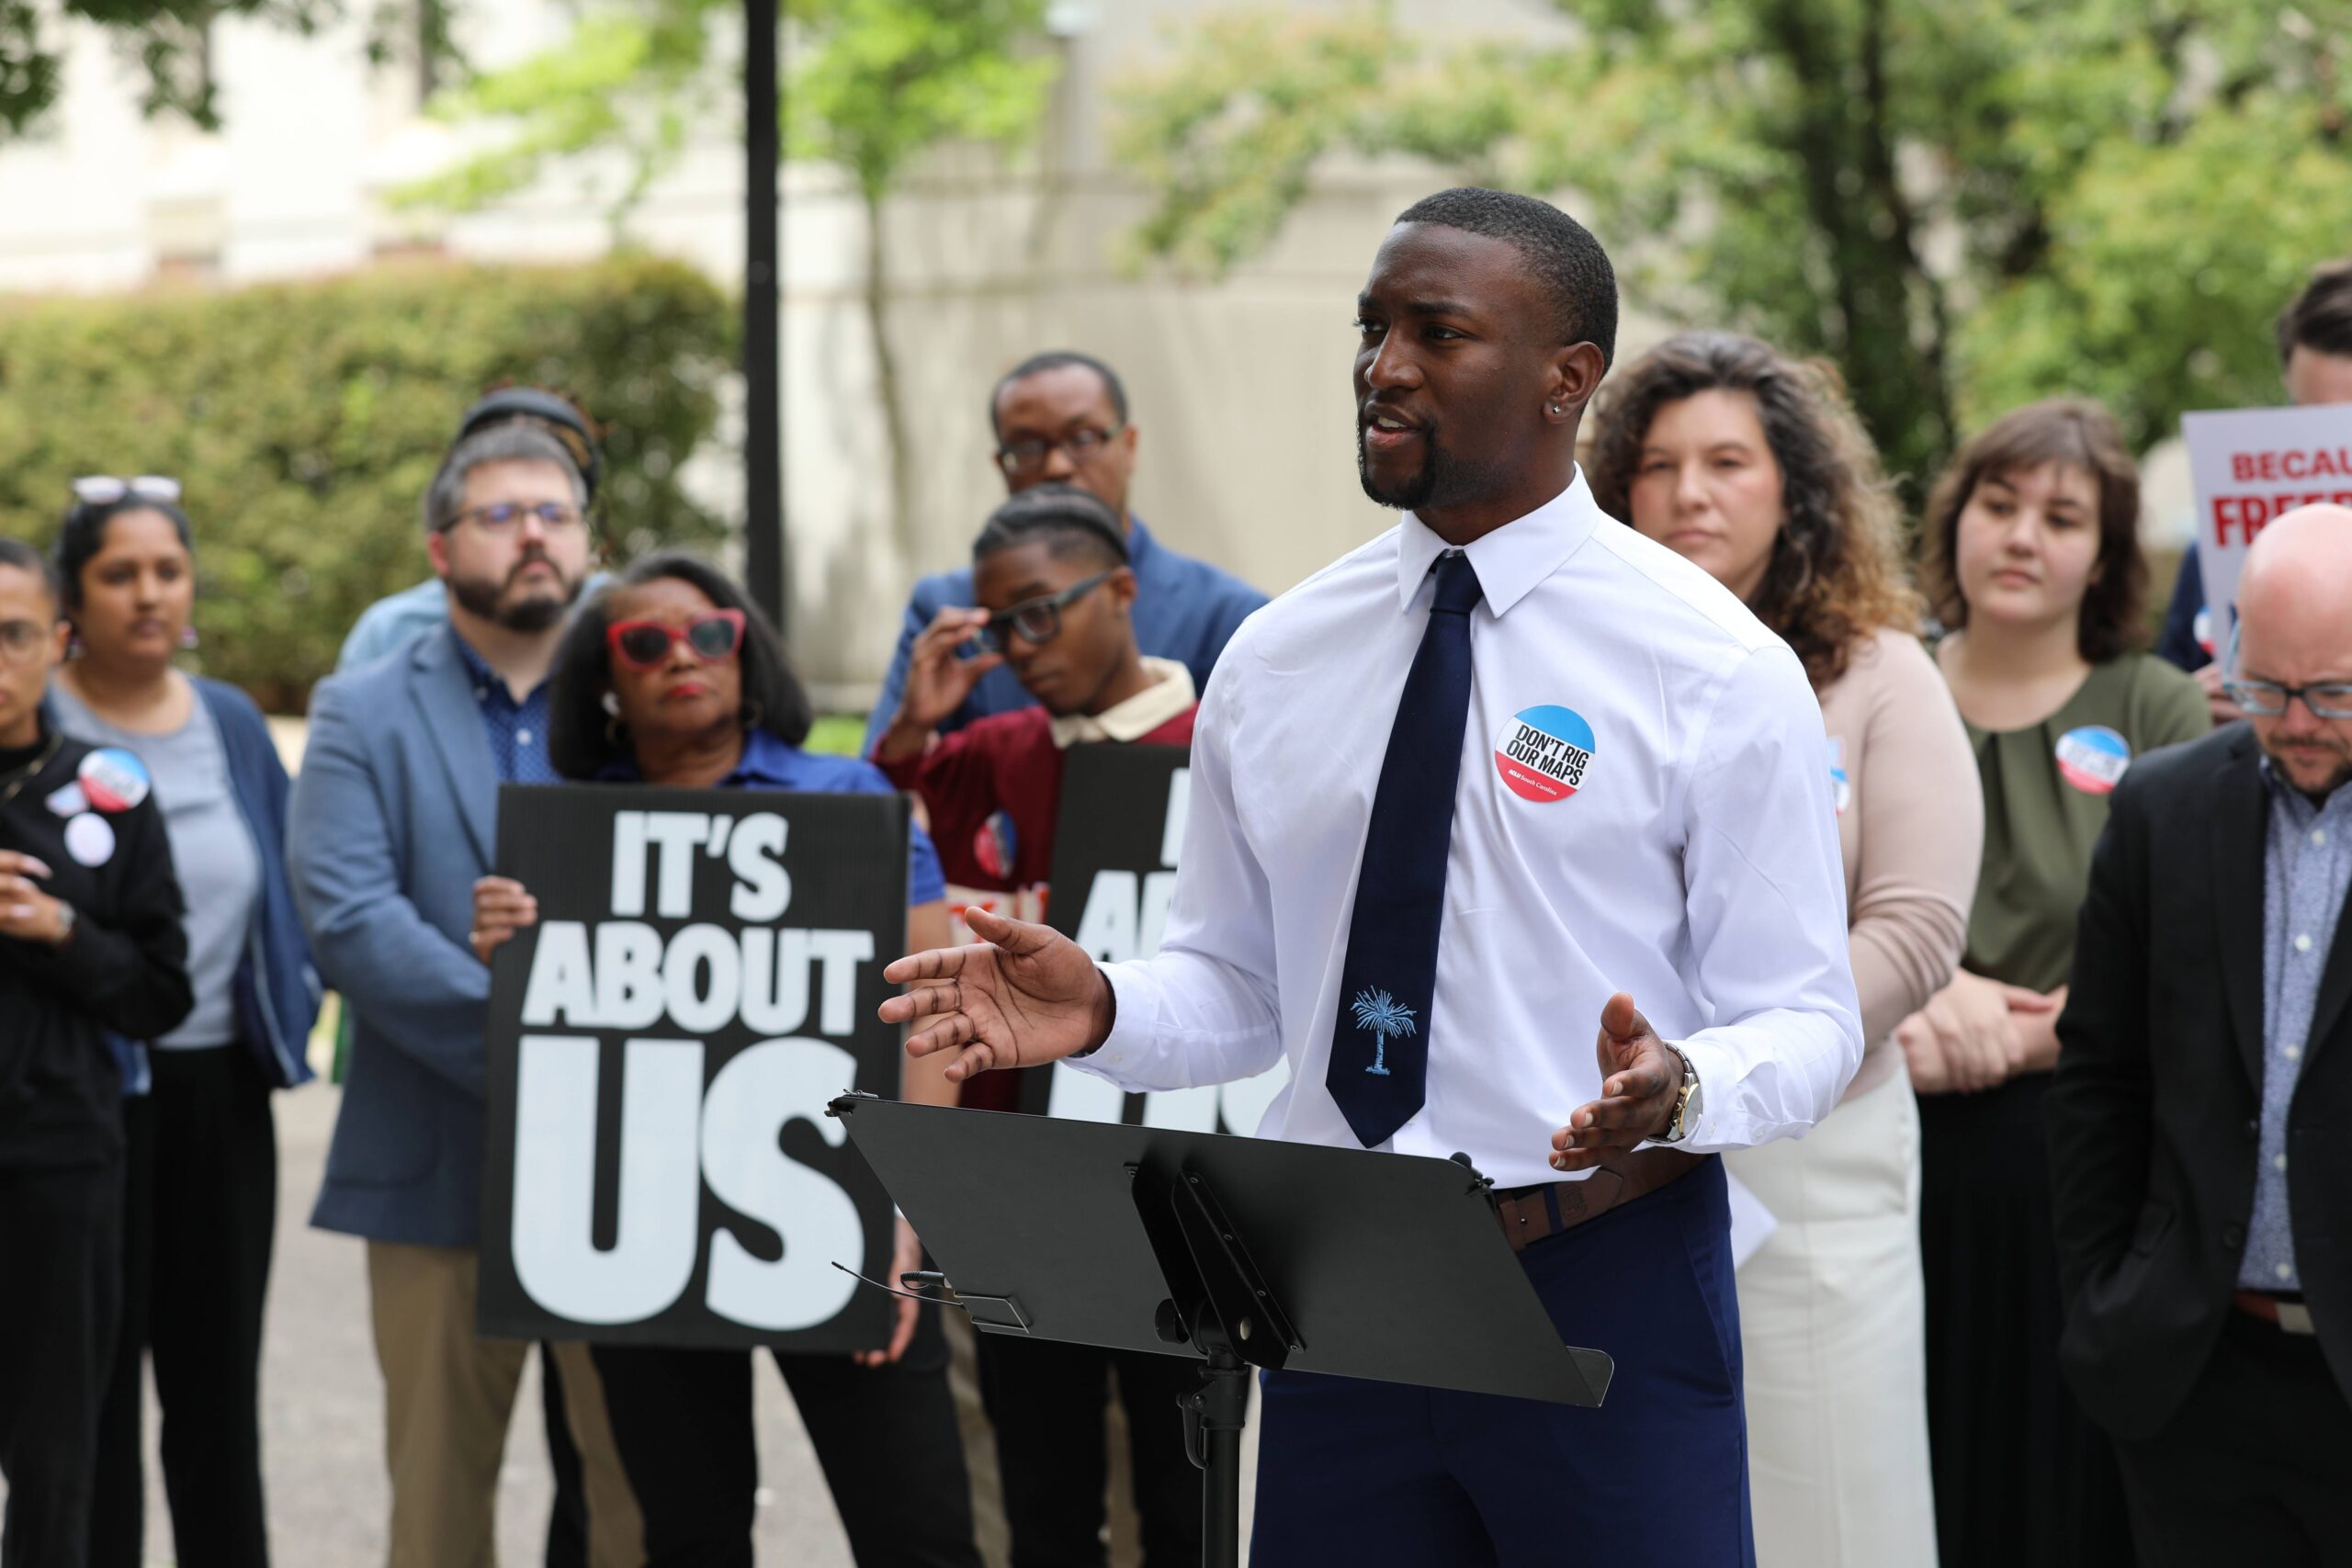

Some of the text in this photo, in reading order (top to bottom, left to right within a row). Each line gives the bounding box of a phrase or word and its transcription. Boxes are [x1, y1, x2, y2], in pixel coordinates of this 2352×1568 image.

[1507, 739, 1583, 785] OUR MAPS
[1515, 724, 1589, 770] DON'T RIG
[1521, 775, 1536, 786] South
[1535, 782, 1557, 795] Carolina
[611, 810, 791, 921] IT'S
[521, 920, 874, 1035] ABOUT
[511, 1034, 865, 1331] US
